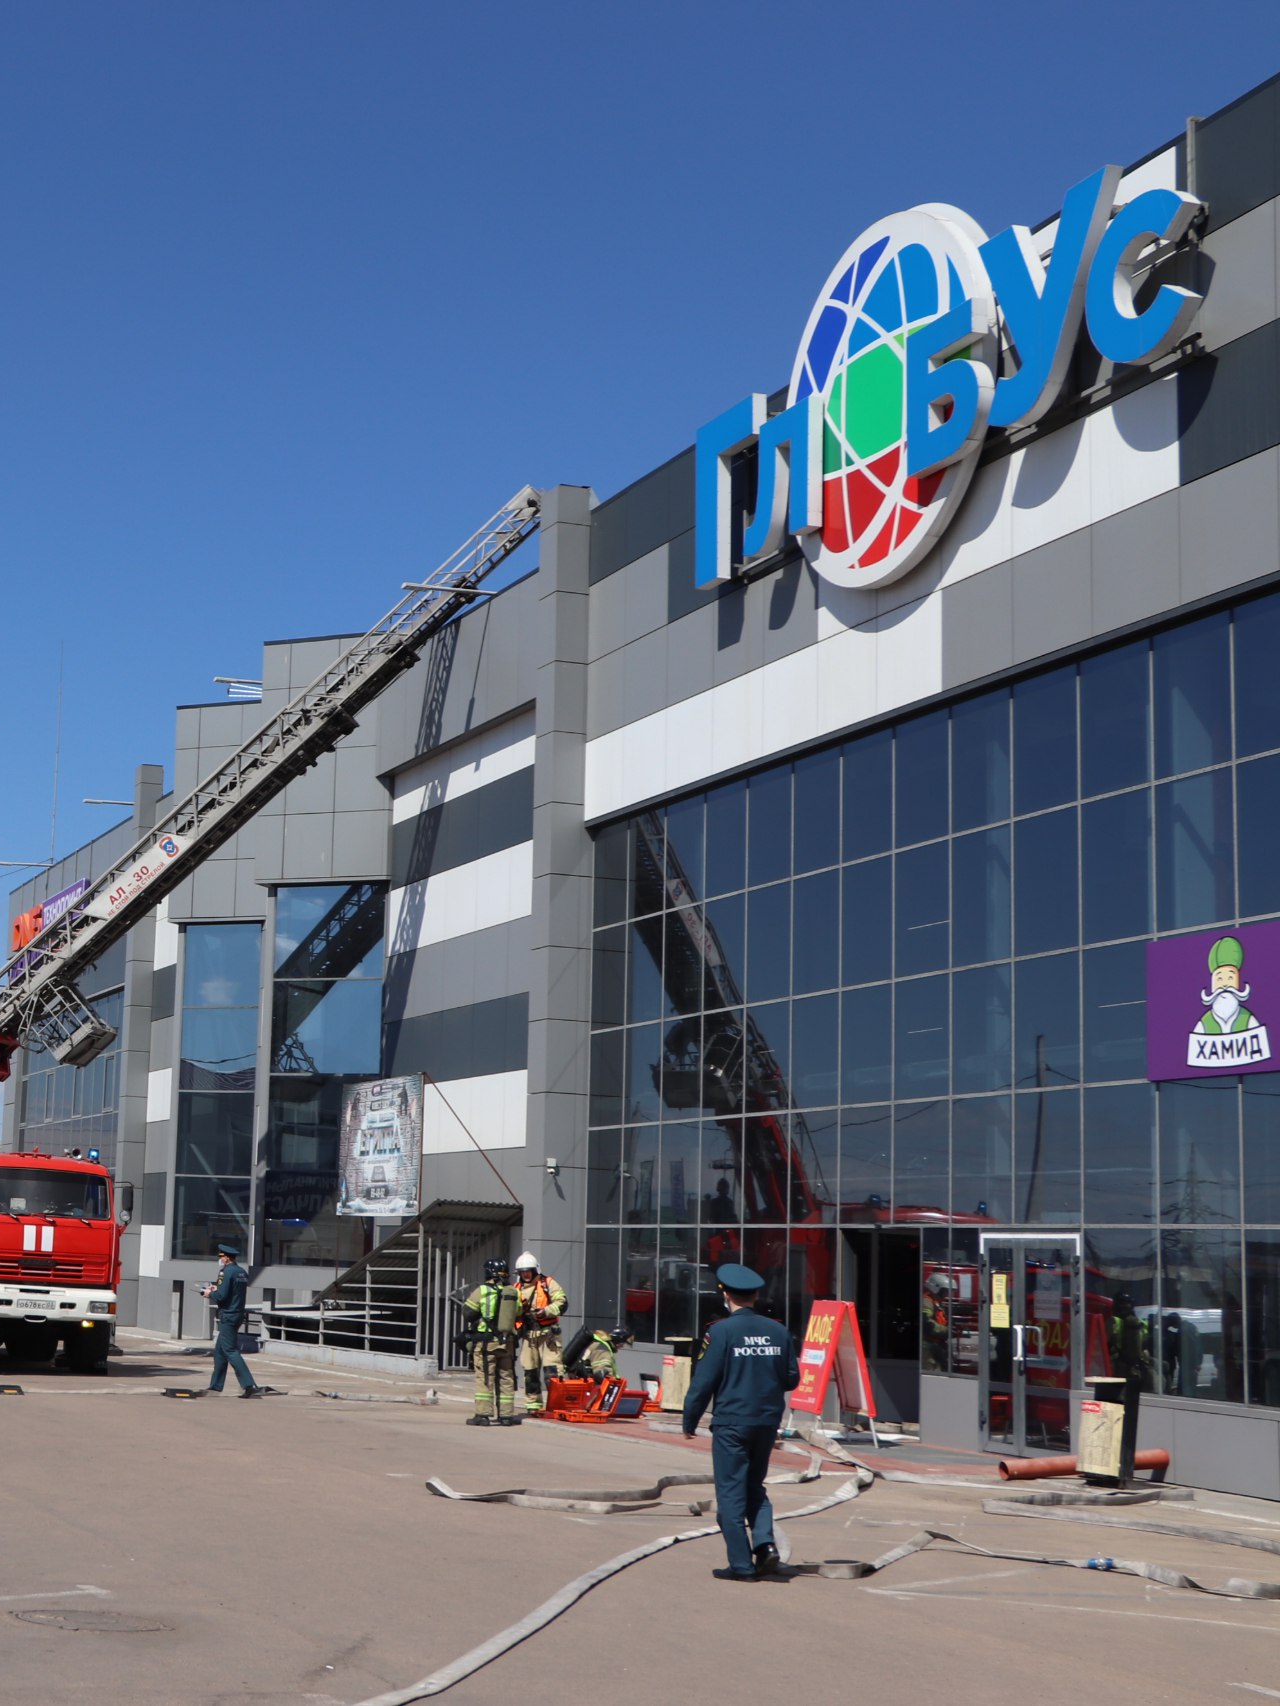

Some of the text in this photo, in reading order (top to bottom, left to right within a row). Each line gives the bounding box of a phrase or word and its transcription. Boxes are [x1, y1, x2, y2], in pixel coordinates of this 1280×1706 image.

[107, 861, 166, 917] НЕ СТОЙ ПОД СТРЕЛОЙ
[109, 886, 126, 905] АЛ
[132, 865, 150, 882] 30
[1196, 1034, 1264, 1060] ХАМИД
[743, 1335, 771, 1346] МЧС
[805, 1313, 836, 1345] КАФЕ
[733, 1346, 782, 1357] РОССИИ
